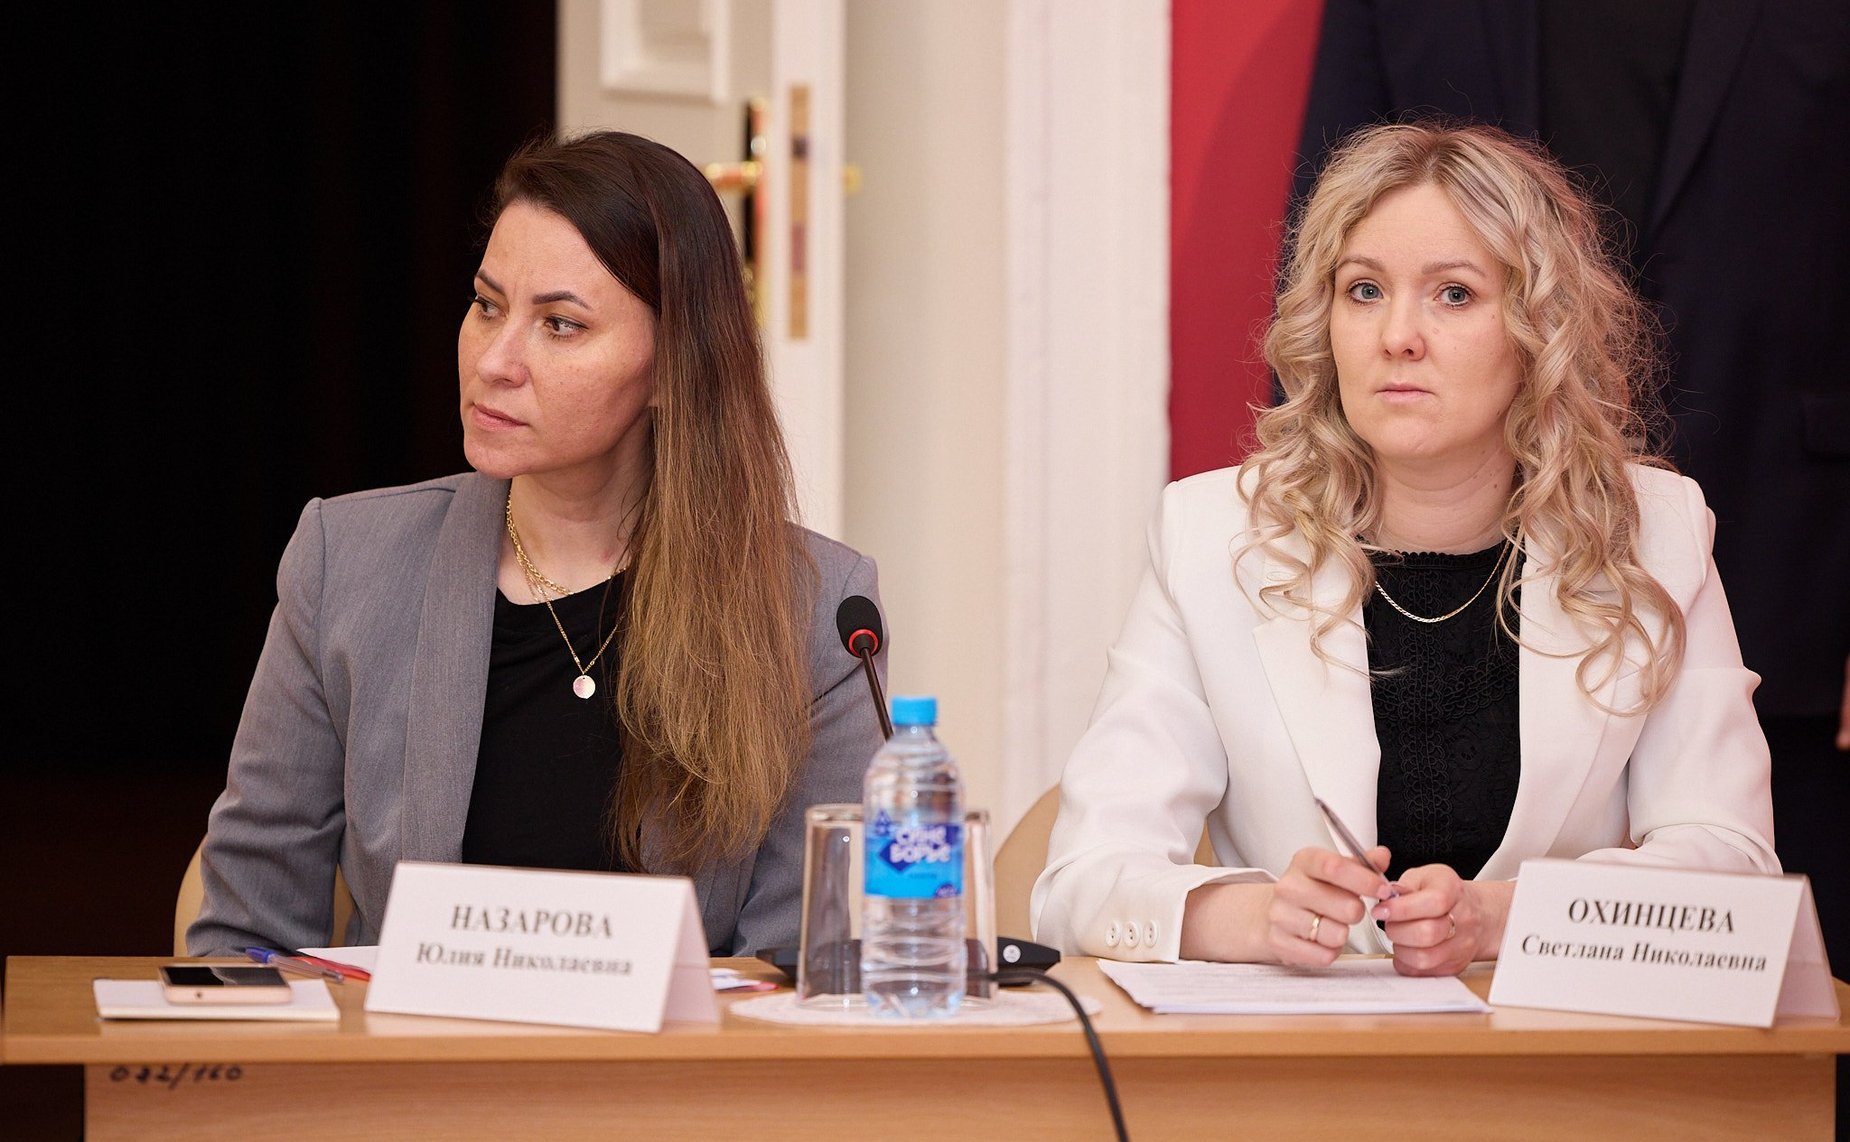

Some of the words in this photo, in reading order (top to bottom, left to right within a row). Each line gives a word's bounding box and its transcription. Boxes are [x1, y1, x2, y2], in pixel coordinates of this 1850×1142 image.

[450, 903, 614, 940] НАЗАРОВА
[1568, 898, 1736, 934] ОХИНЦЕВА
[416, 942, 485, 968] Юлия
[492, 946, 633, 976] Николаевна
[1521, 934, 1624, 962] Светлана
[1631, 942, 1767, 972] Николаевна
